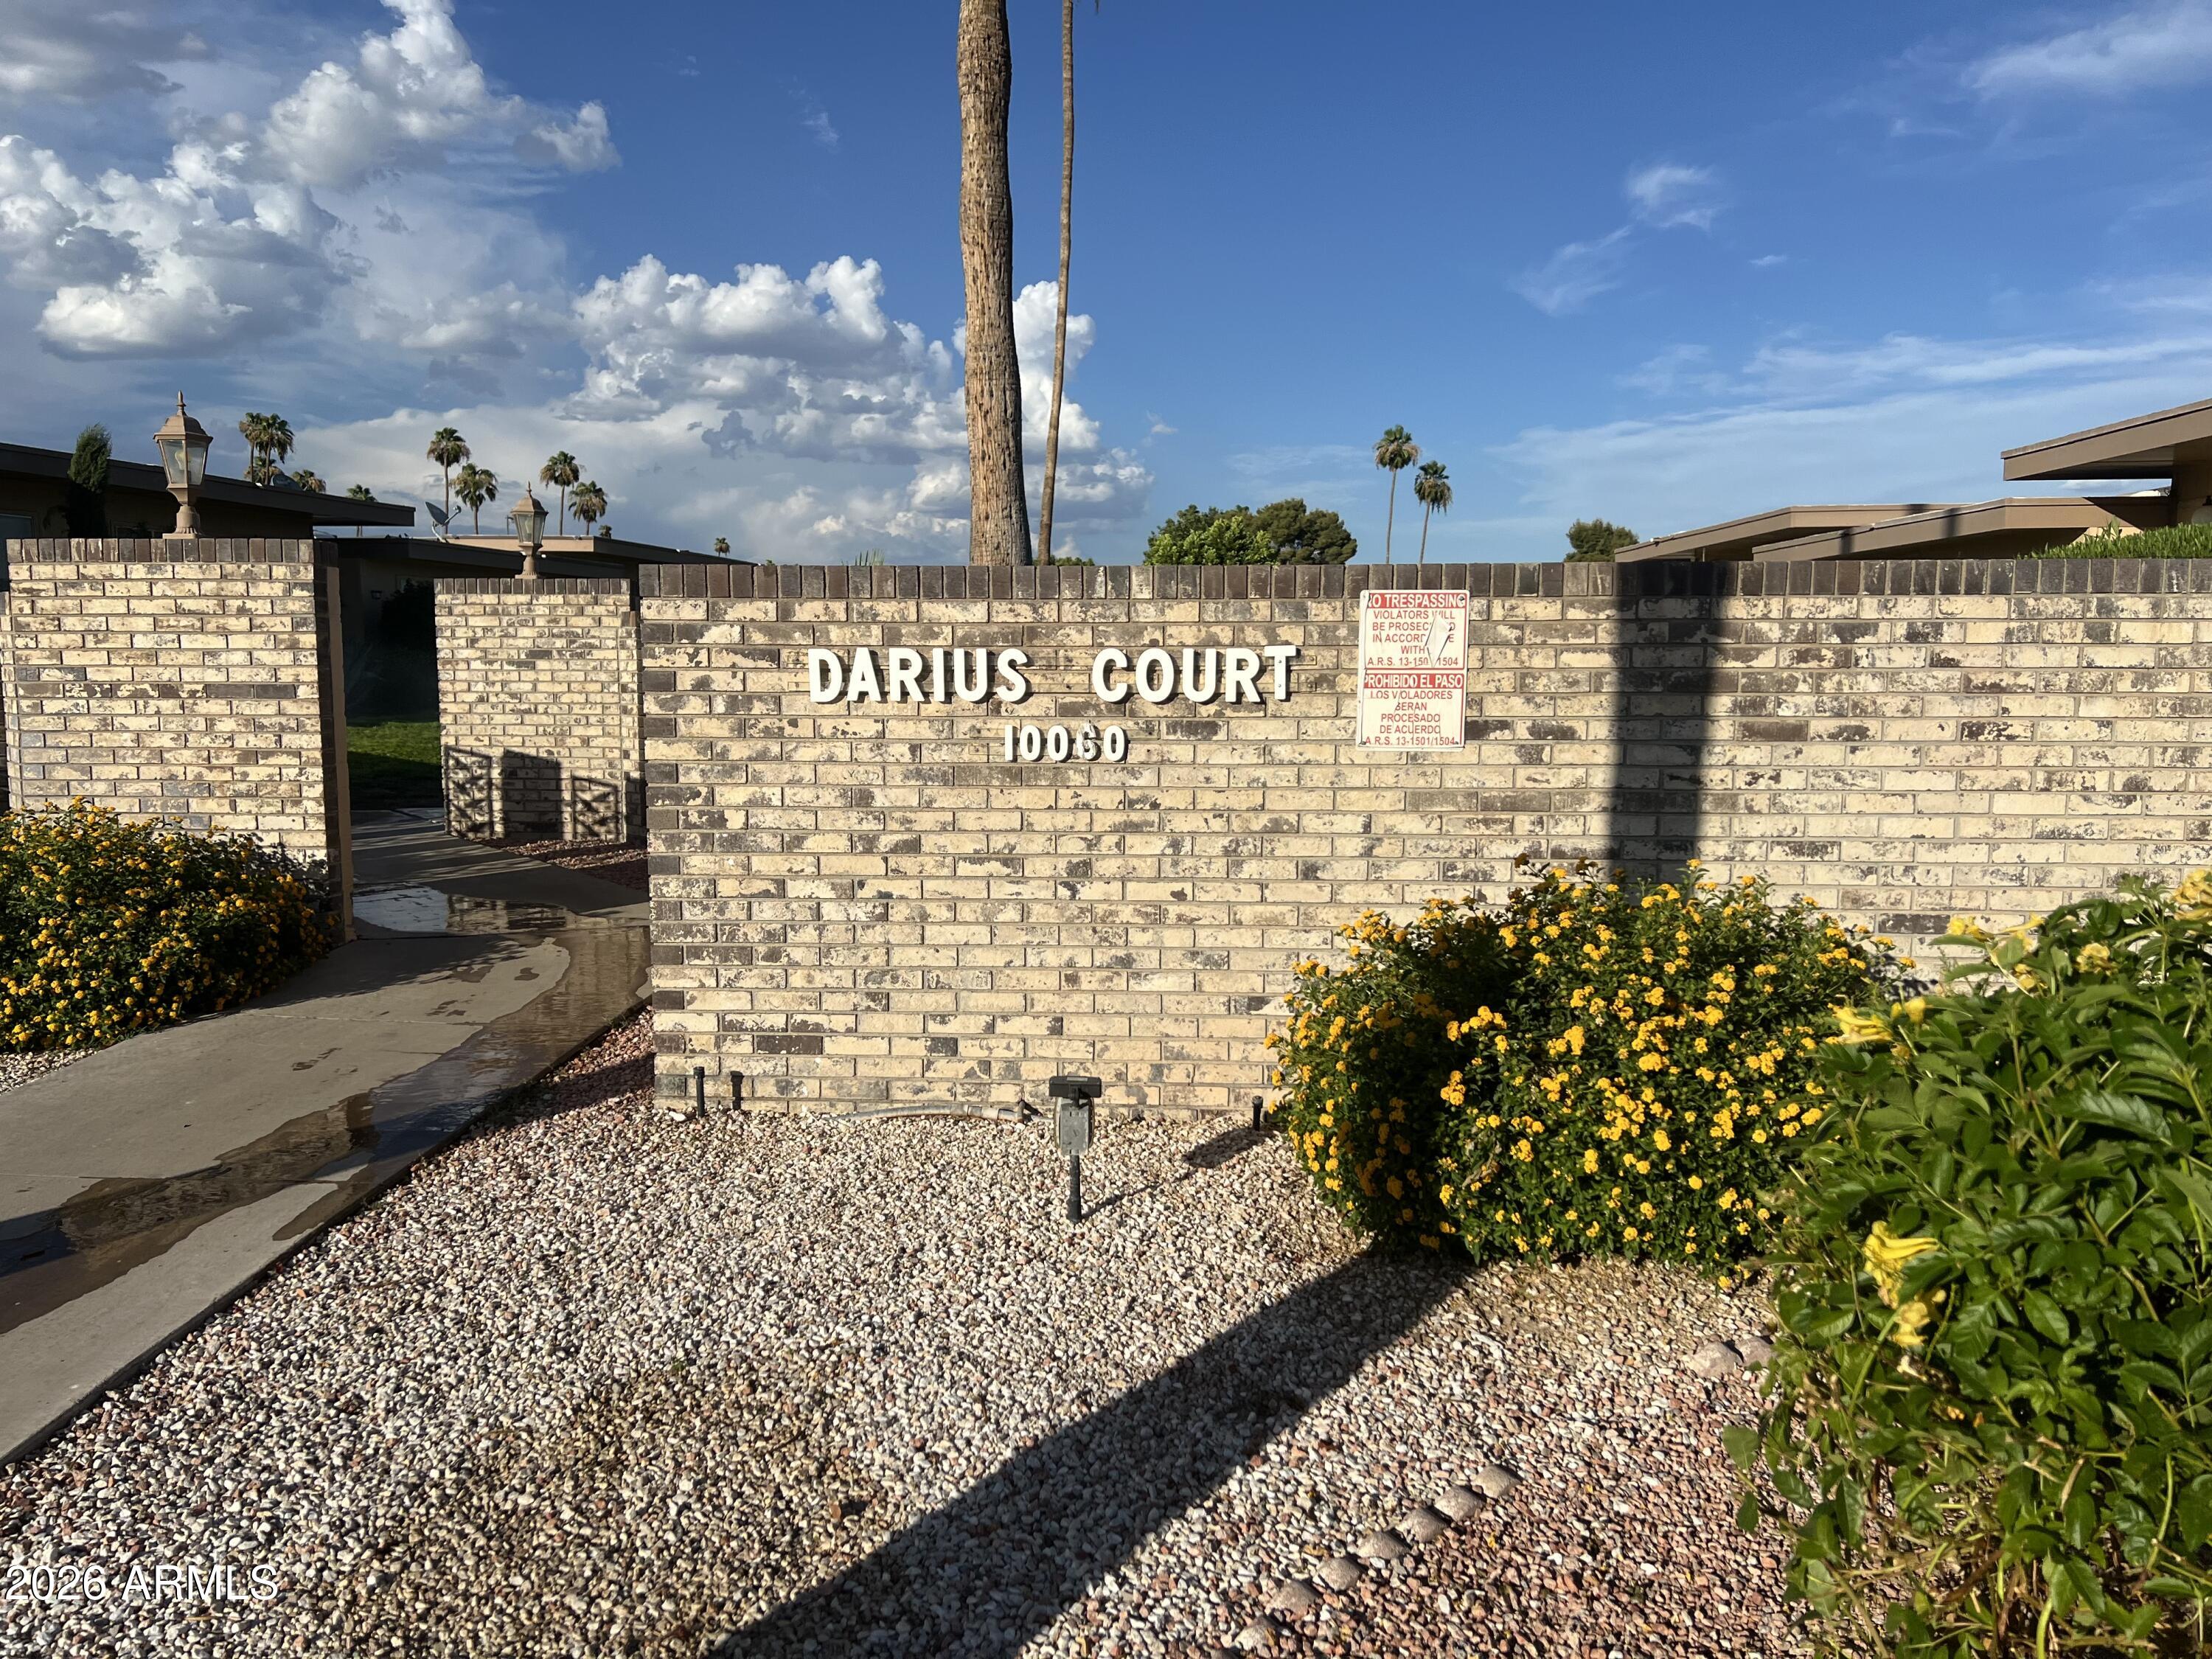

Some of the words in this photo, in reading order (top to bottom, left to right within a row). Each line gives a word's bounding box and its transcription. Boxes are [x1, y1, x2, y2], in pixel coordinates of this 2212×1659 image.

[1385, 594, 1466, 608] TRESPASSING
[1374, 610, 1429, 619] VIOLATORS
[1372, 622, 1385, 631] BE
[1388, 622, 1455, 631] PROSECD
[1372, 633, 1382, 643] IN
[1401, 645, 1425, 655] WITH
[1367, 657, 1395, 666] A.R.S.
[1399, 657, 1458, 666] 13-1501504
[808, 647, 1030, 703] DARIUS
[1091, 644, 1297, 703] COURT
[1420, 674, 1433, 688] EL
[1435, 674, 1463, 688] PASO
[1371, 690, 1389, 699] LOS
[1381, 713, 1441, 723] PROCESADO
[1380, 725, 1392, 734] DE
[1394, 725, 1441, 734] ACUERDO
[1005, 721, 1125, 762] 10060
[1365, 736, 1392, 745] A.R.S.
[1396, 736, 1455, 745] 13-1501/1504
